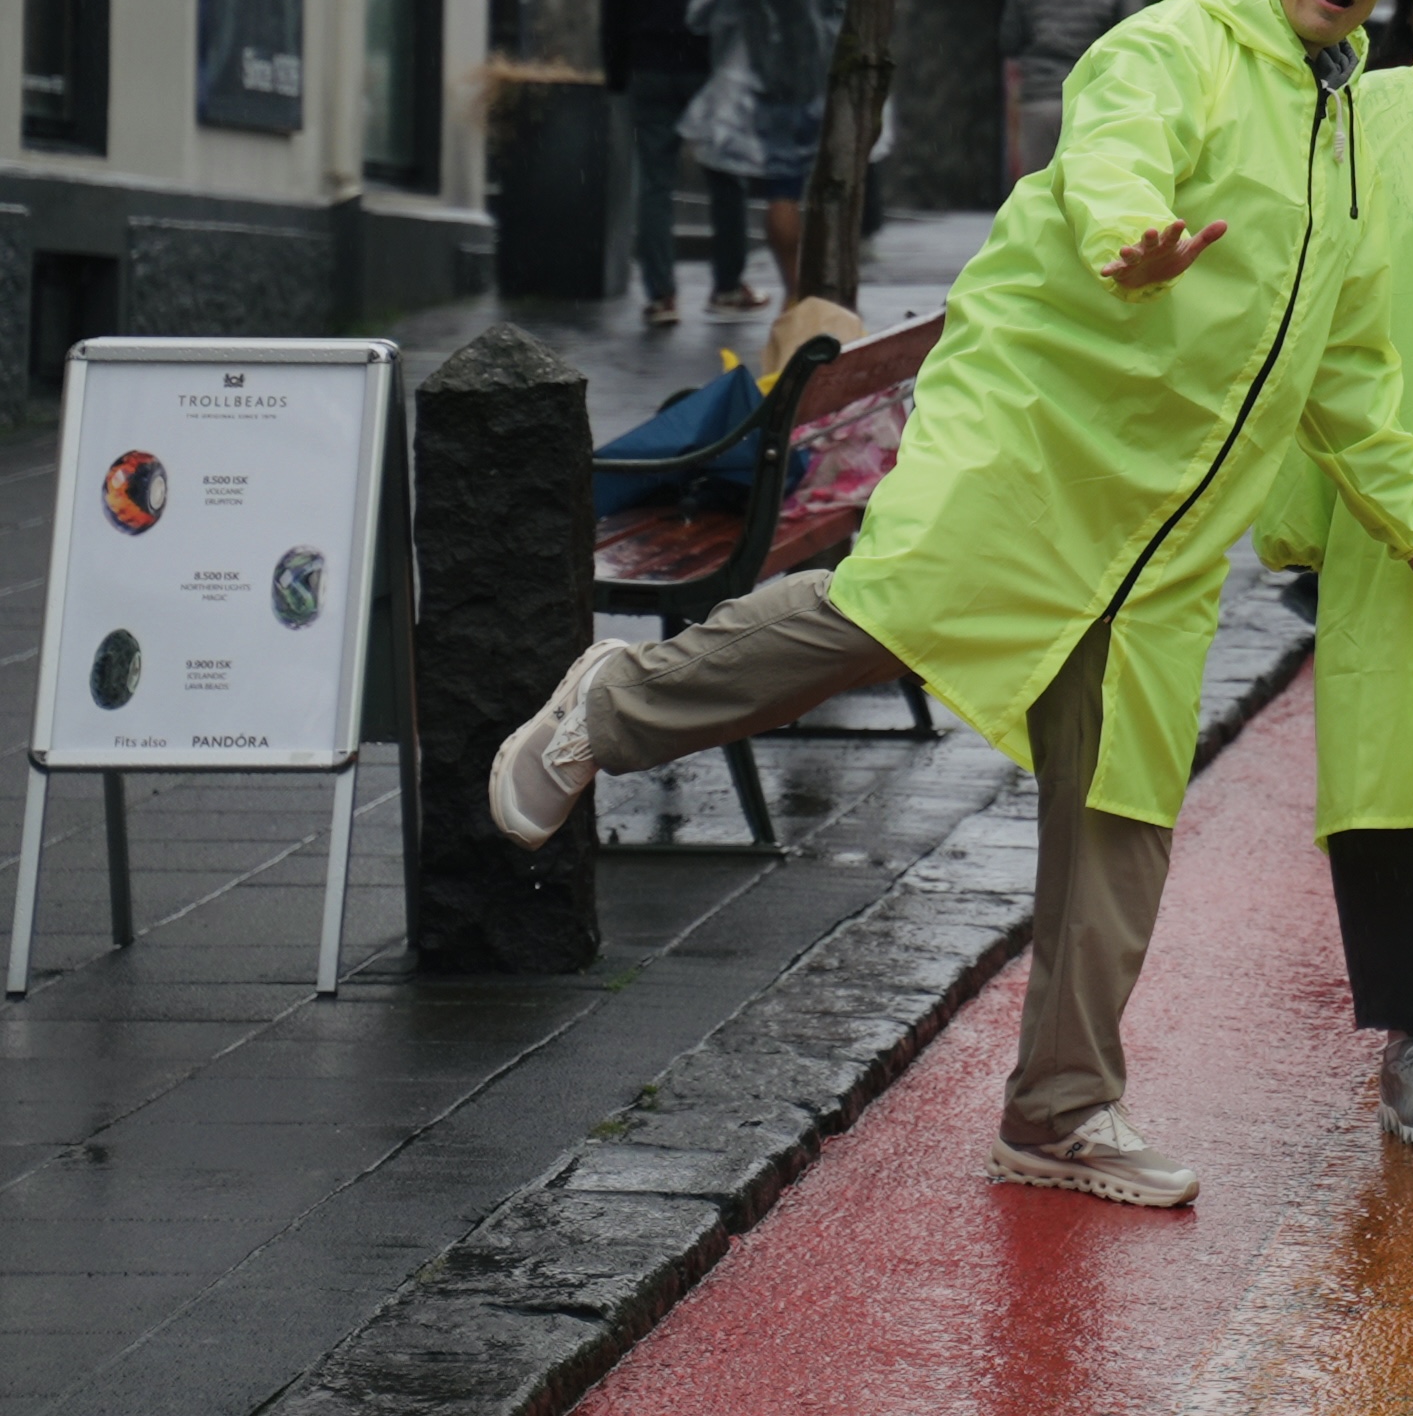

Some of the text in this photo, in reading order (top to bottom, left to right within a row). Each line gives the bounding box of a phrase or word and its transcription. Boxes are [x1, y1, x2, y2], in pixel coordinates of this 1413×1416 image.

[242, 45, 273, 92] Since
[178, 395, 288, 408] TROLLBEADS
[202, 476, 248, 484] 8.500 ISK
[194, 572, 240, 580] 8.500 ISK
[216, 660, 232, 669] ISK
[187, 672, 226, 680] ICELANDIC
[114, 736, 167, 748] Fits also
